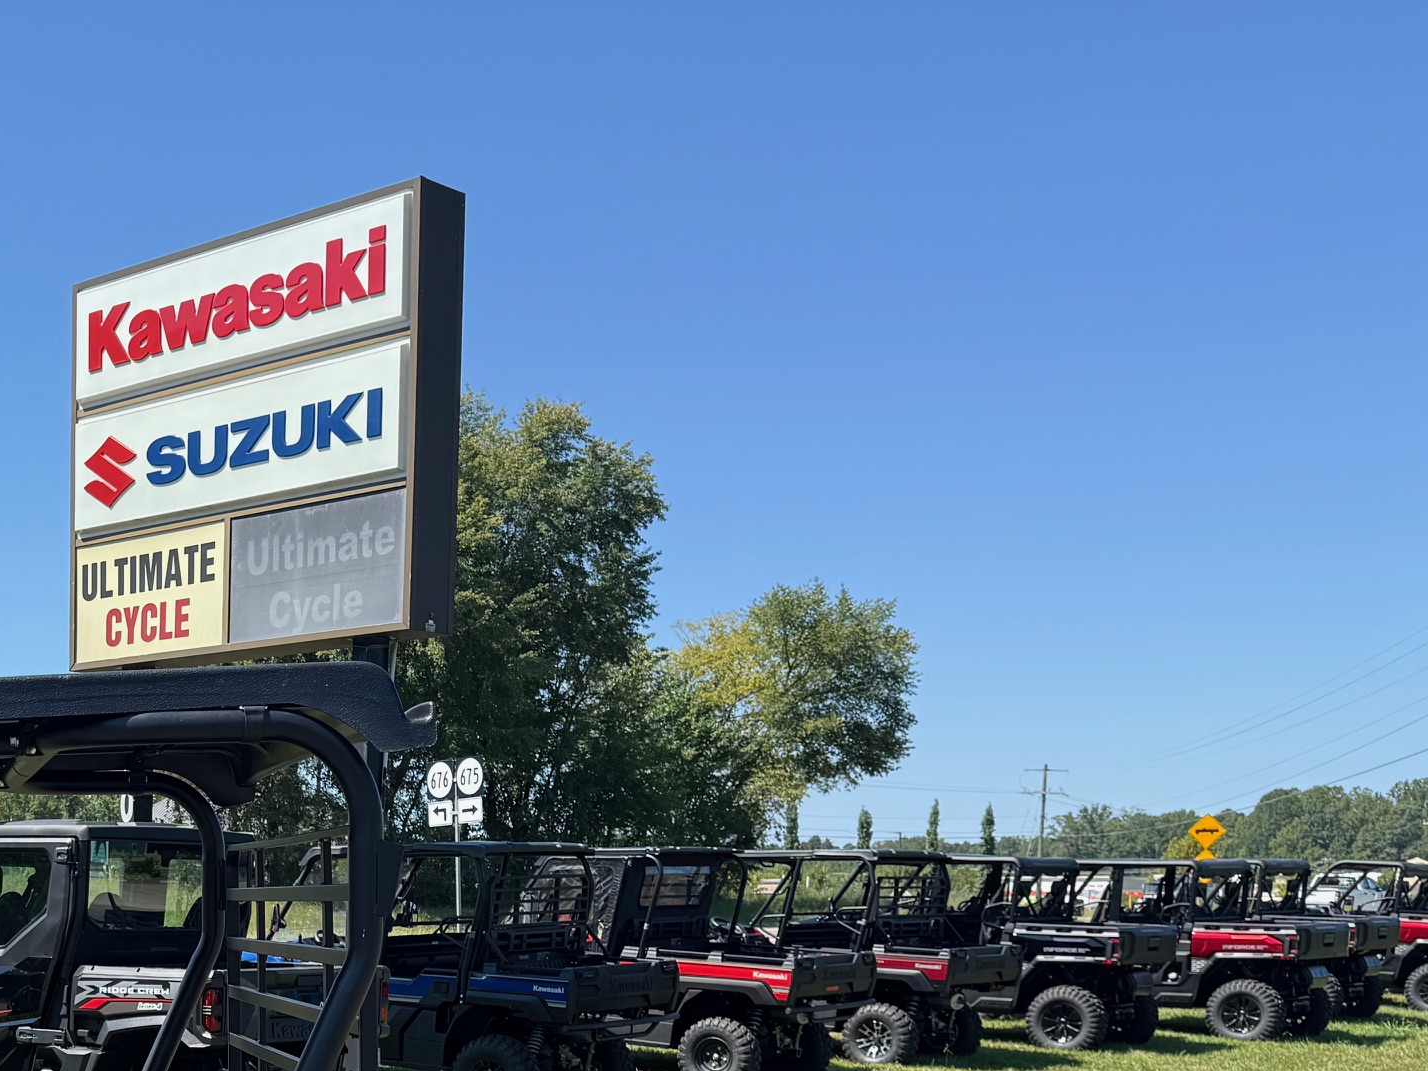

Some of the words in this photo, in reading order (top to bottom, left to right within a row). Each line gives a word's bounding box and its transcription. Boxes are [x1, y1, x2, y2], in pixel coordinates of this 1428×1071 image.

[88, 224, 387, 373] Kawasaki
[146, 387, 383, 485] SUZUKI
[82, 541, 215, 601] ULTIMATE
[247, 520, 395, 576] Ultimate
[106, 598, 190, 647] CYCLE
[269, 582, 363, 633] Cycle
[431, 771, 448, 789] 676
[461, 768, 479, 785] 675
[533, 985, 565, 994] Kawasaki
[753, 971, 788, 980] Kawasaki
